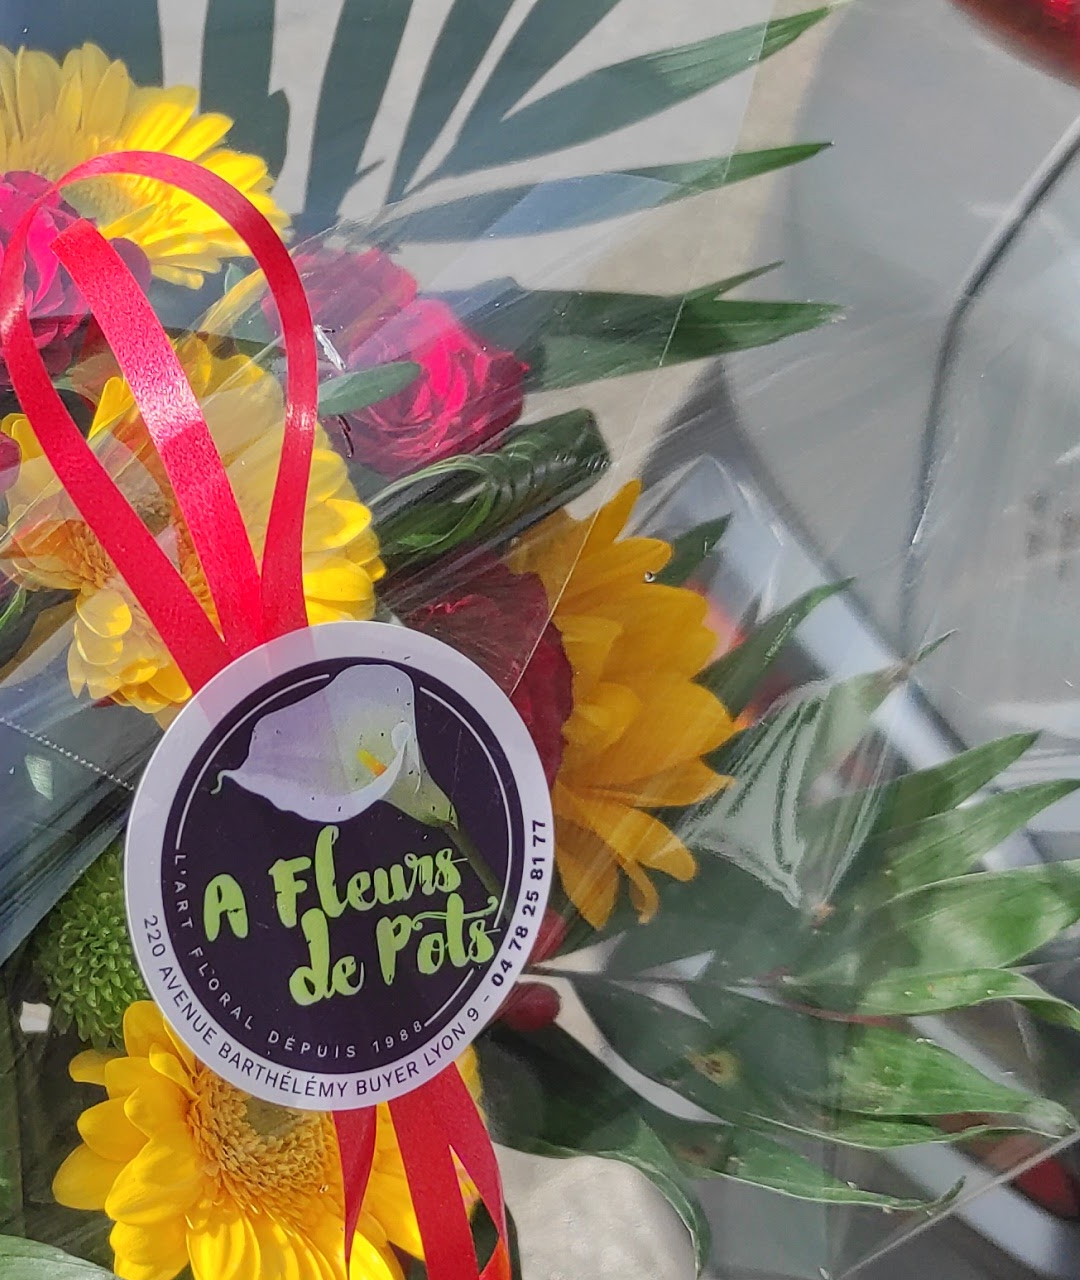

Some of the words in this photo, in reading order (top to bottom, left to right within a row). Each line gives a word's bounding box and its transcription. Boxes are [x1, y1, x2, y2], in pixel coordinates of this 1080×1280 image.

[532, 820, 546, 848] 77
[203, 873, 249, 942] A
[268, 824, 468, 928] Fleurs
[530, 856, 545, 880] 81
[522, 890, 539, 917] 25
[144, 915, 166, 957] 220
[174, 854, 193, 928] L'ART
[189, 947, 253, 1030] FLORAL
[372, 1021, 422, 1053] 1988
[289, 908, 364, 1006] de
[376, 893, 500, 986] Pots
[508, 925, 529, 953] 78
[491, 958, 513, 988] 04
[159, 966, 218, 1045] AVENUE
[466, 1007, 479, 1022] 9
[424, 1022, 466, 1066] LYON
[218, 1041, 352, 1097] BARTHÉLÉMY
[356, 1061, 420, 1096] BUYER
